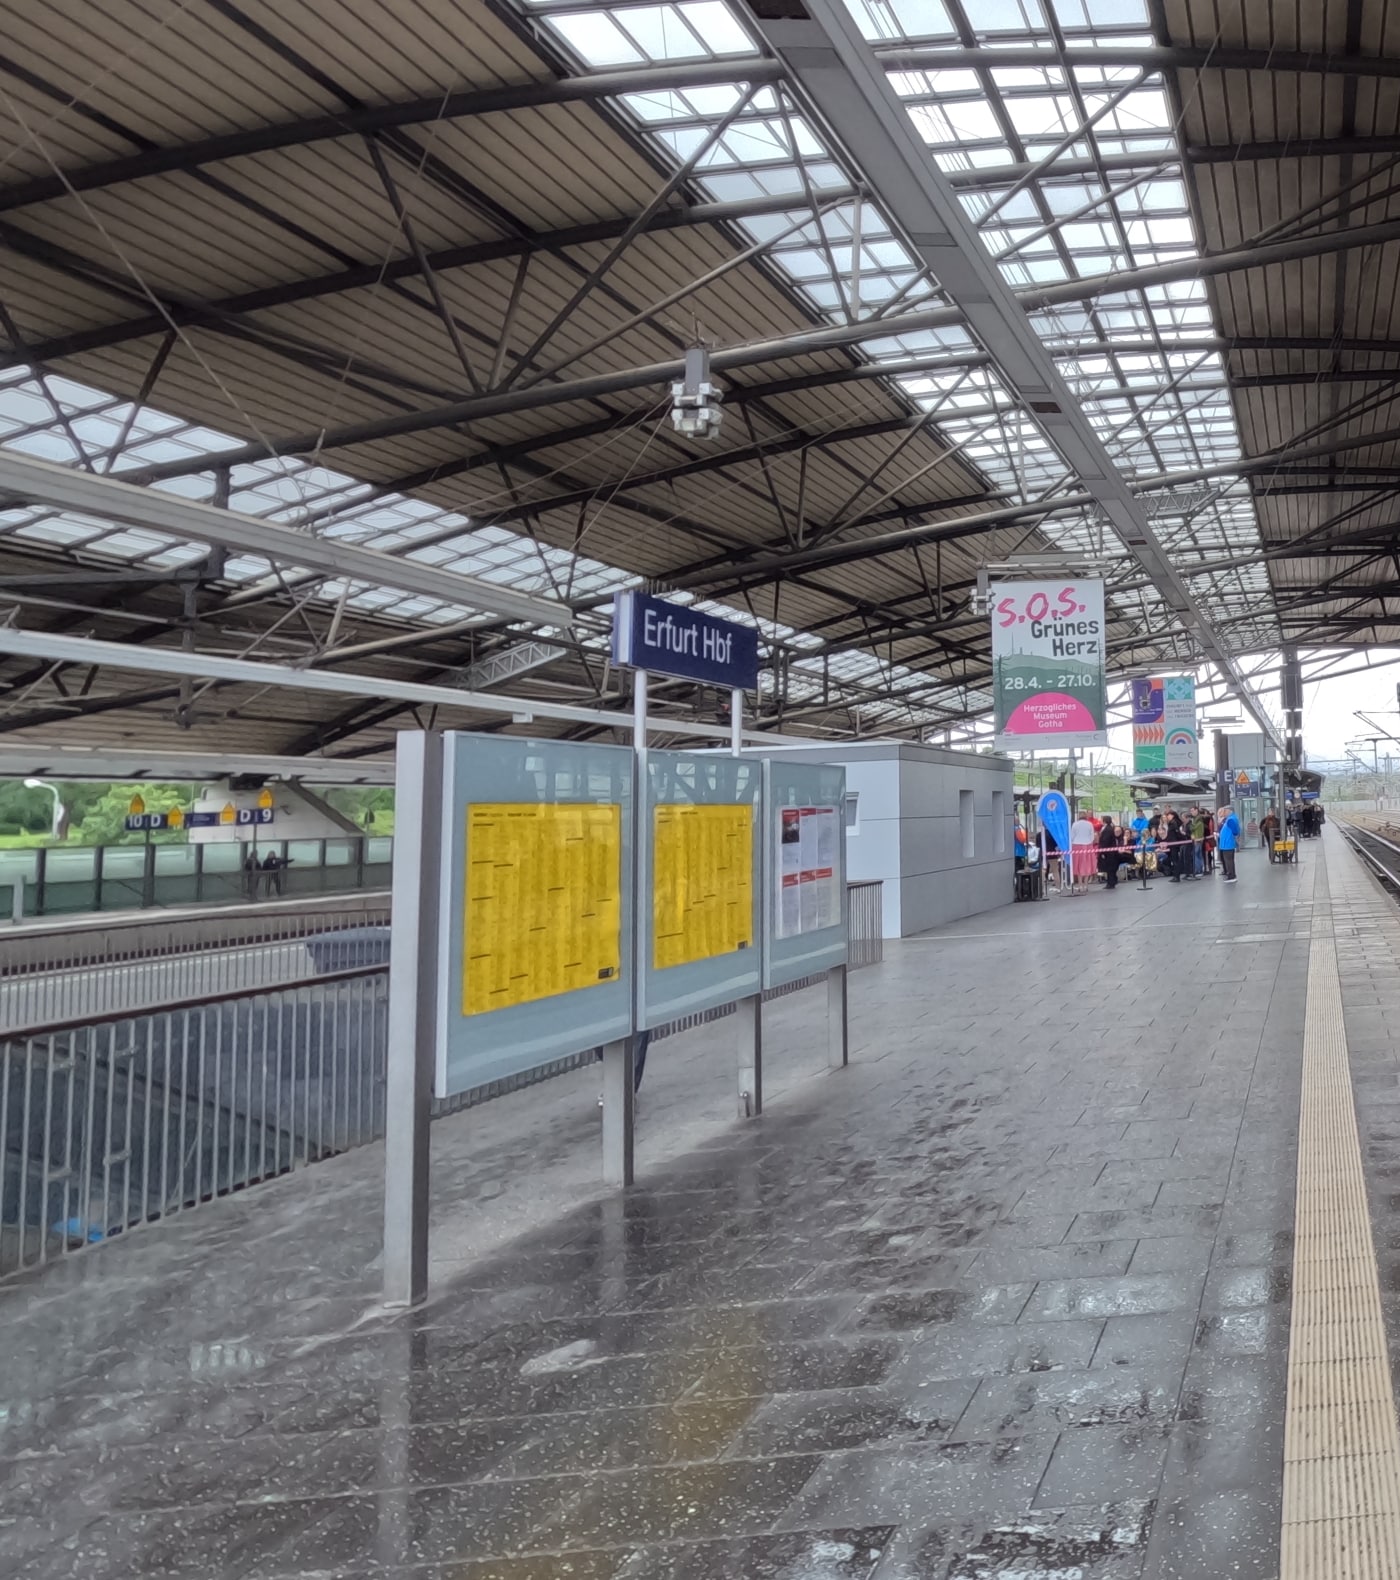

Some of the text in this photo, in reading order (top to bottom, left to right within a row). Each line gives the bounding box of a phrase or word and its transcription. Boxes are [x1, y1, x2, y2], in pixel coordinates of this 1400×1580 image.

[997, 587, 1086, 628] S.O.S.
[1031, 616, 1099, 639] Grünes
[644, 609, 732, 664] Erfurt Hbf
[1052, 638, 1098, 656] Herz
[1004, 676, 1042, 690] 28.4.
[1057, 674, 1096, 688] 27.10.
[1023, 703, 1077, 713] Herzogliches
[1033, 712, 1067, 720] Museum
[1038, 720, 1063, 728] Gotha
[1223, 769, 1233, 783] E
[128, 815, 161, 827] 10 D
[239, 810, 272, 823] D 9
